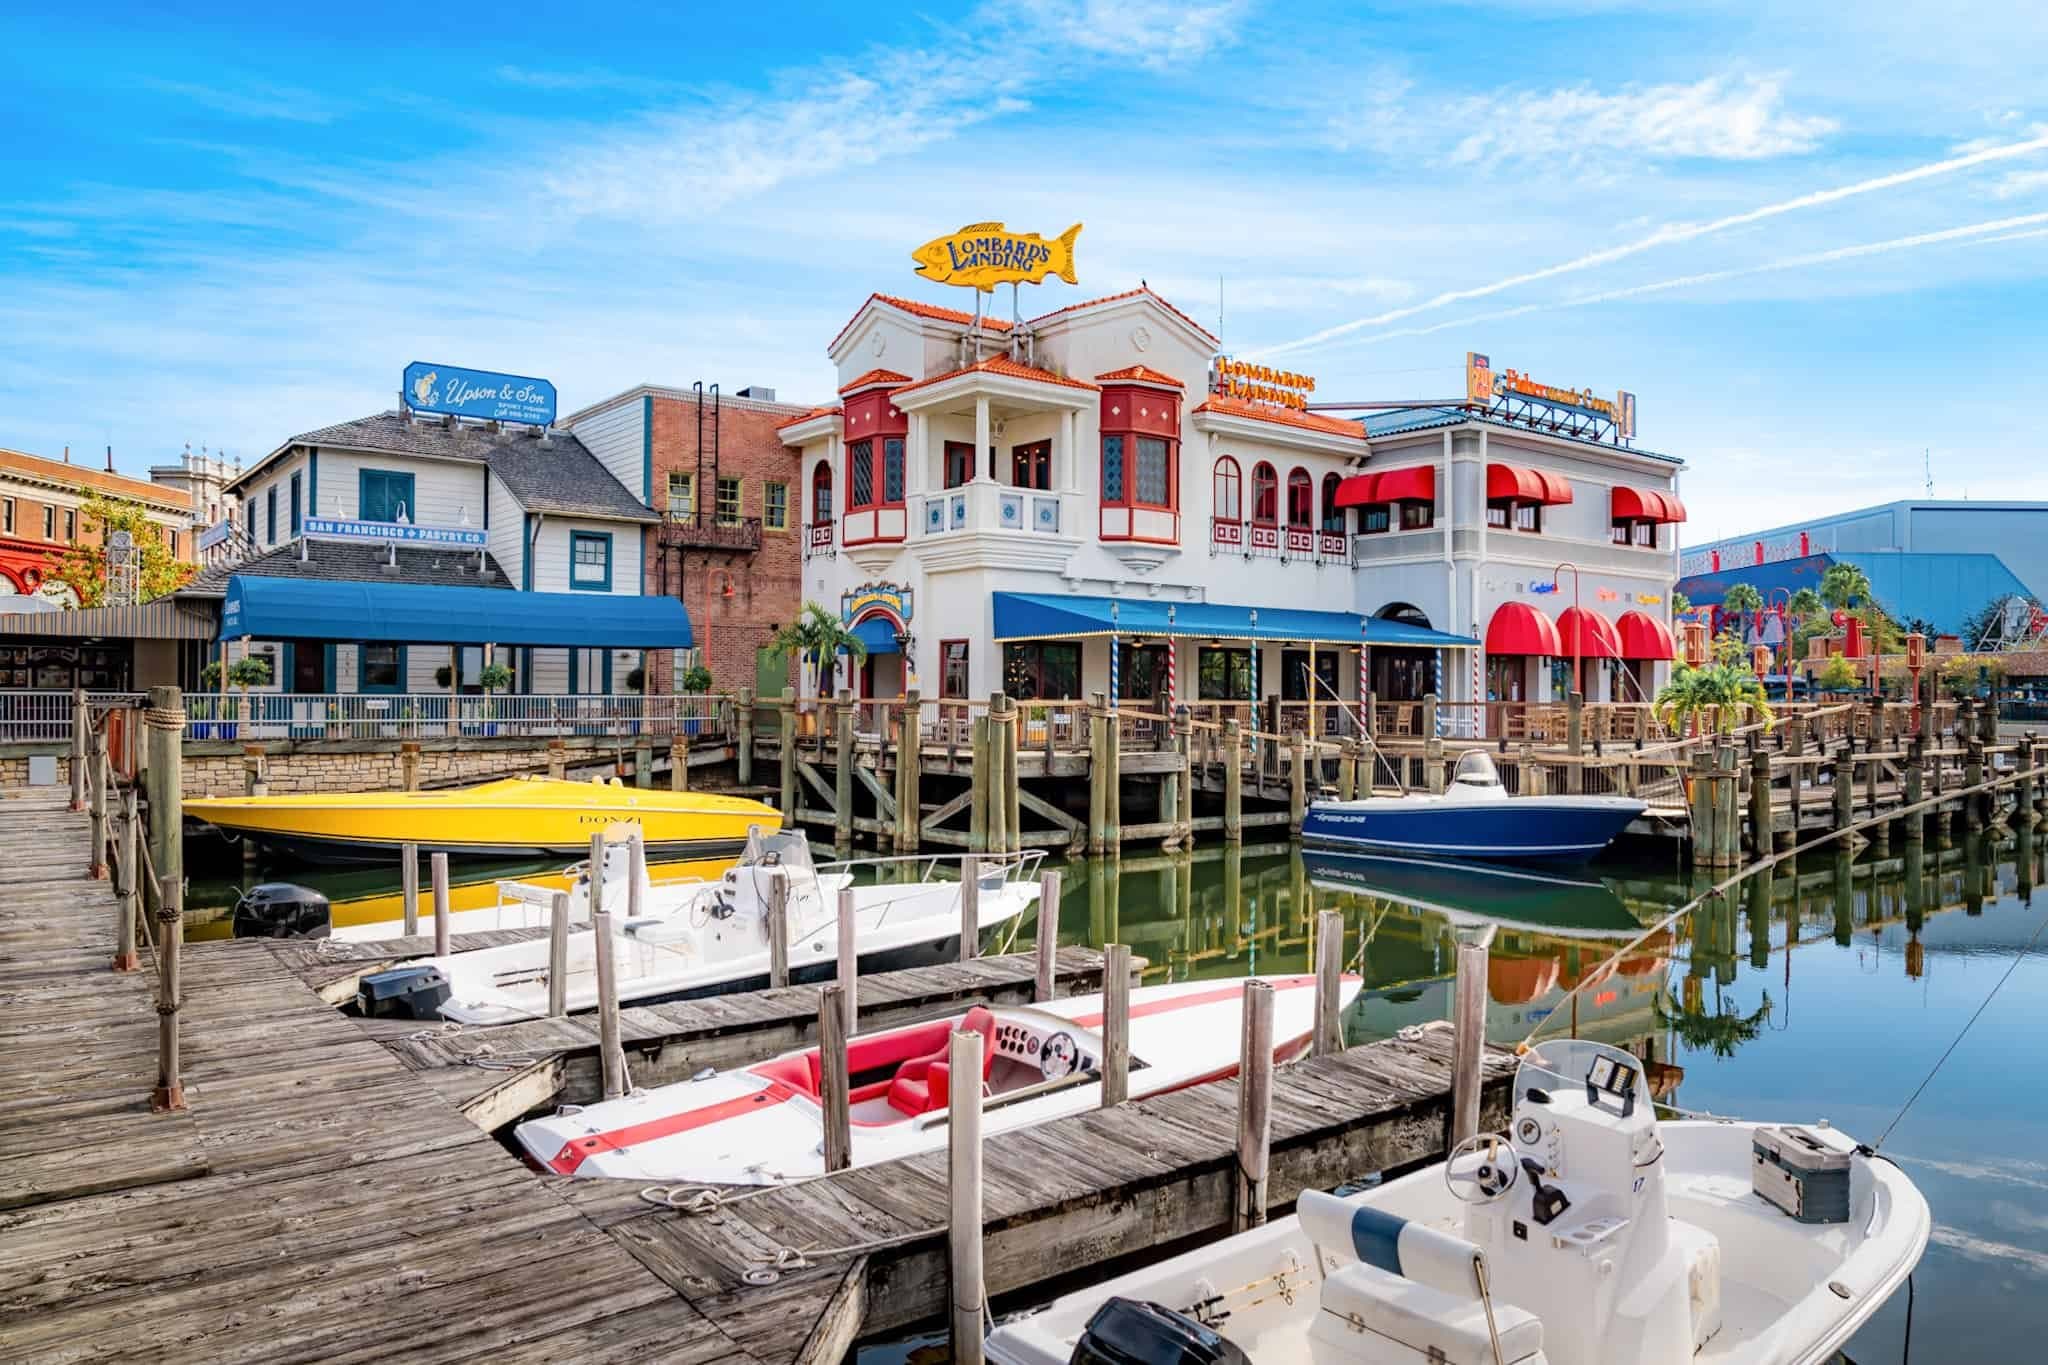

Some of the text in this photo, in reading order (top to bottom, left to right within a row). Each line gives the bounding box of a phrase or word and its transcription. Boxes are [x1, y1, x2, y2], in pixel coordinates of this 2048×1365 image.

[946, 237, 1051, 266] LOMBARD'S
[948, 248, 1034, 272] LANDING
[445, 378, 545, 407] Upson & Son
[309, 522, 483, 544] SAN FRANCISCO PASTRY CO.
[579, 815, 641, 824] DONZI
